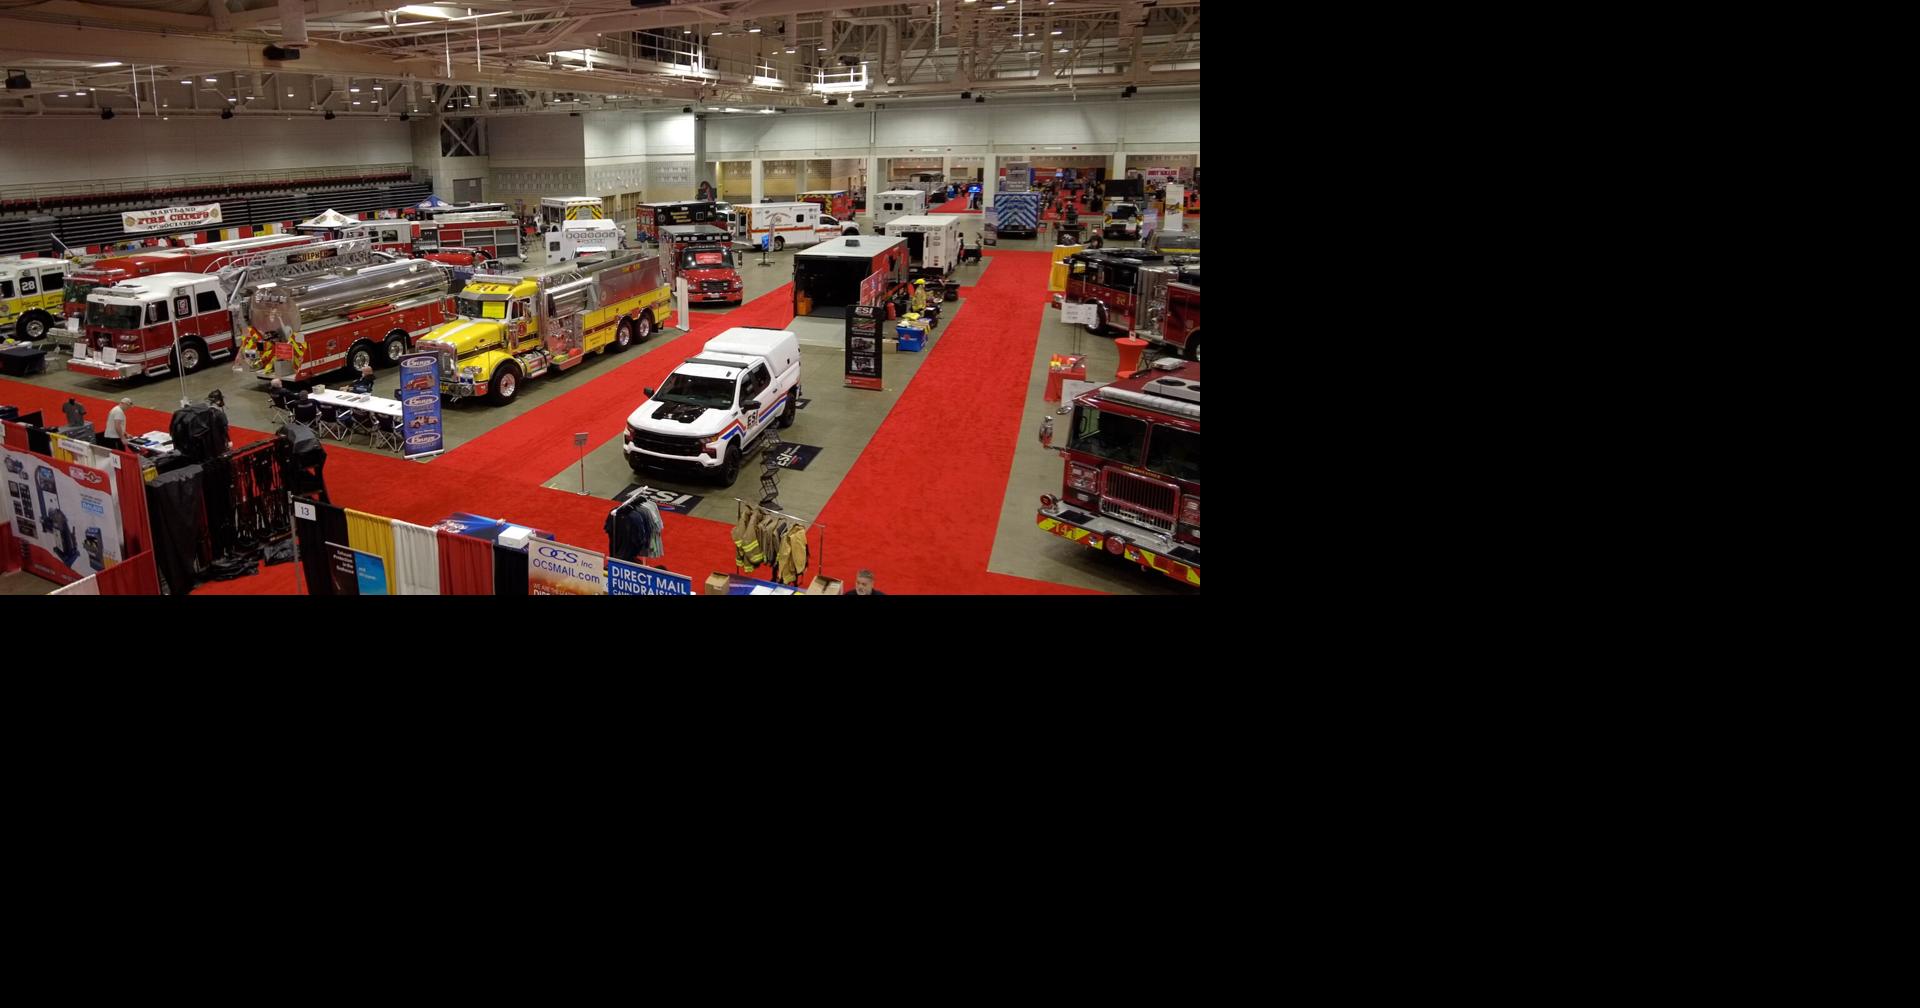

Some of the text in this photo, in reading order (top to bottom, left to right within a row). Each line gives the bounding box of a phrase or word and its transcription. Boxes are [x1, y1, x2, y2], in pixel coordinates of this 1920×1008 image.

[151, 207, 196, 216] MARYLAND
[138, 211, 209, 225] FIRE CHIEFS
[21, 280, 35, 291] 28
[855, 306, 873, 314] ESI
[301, 507, 310, 516] 13
[580, 560, 593, 569] Inc
[532, 558, 601, 584] OCSMAIL.com
[612, 566, 687, 595] DIRECT MAIL
